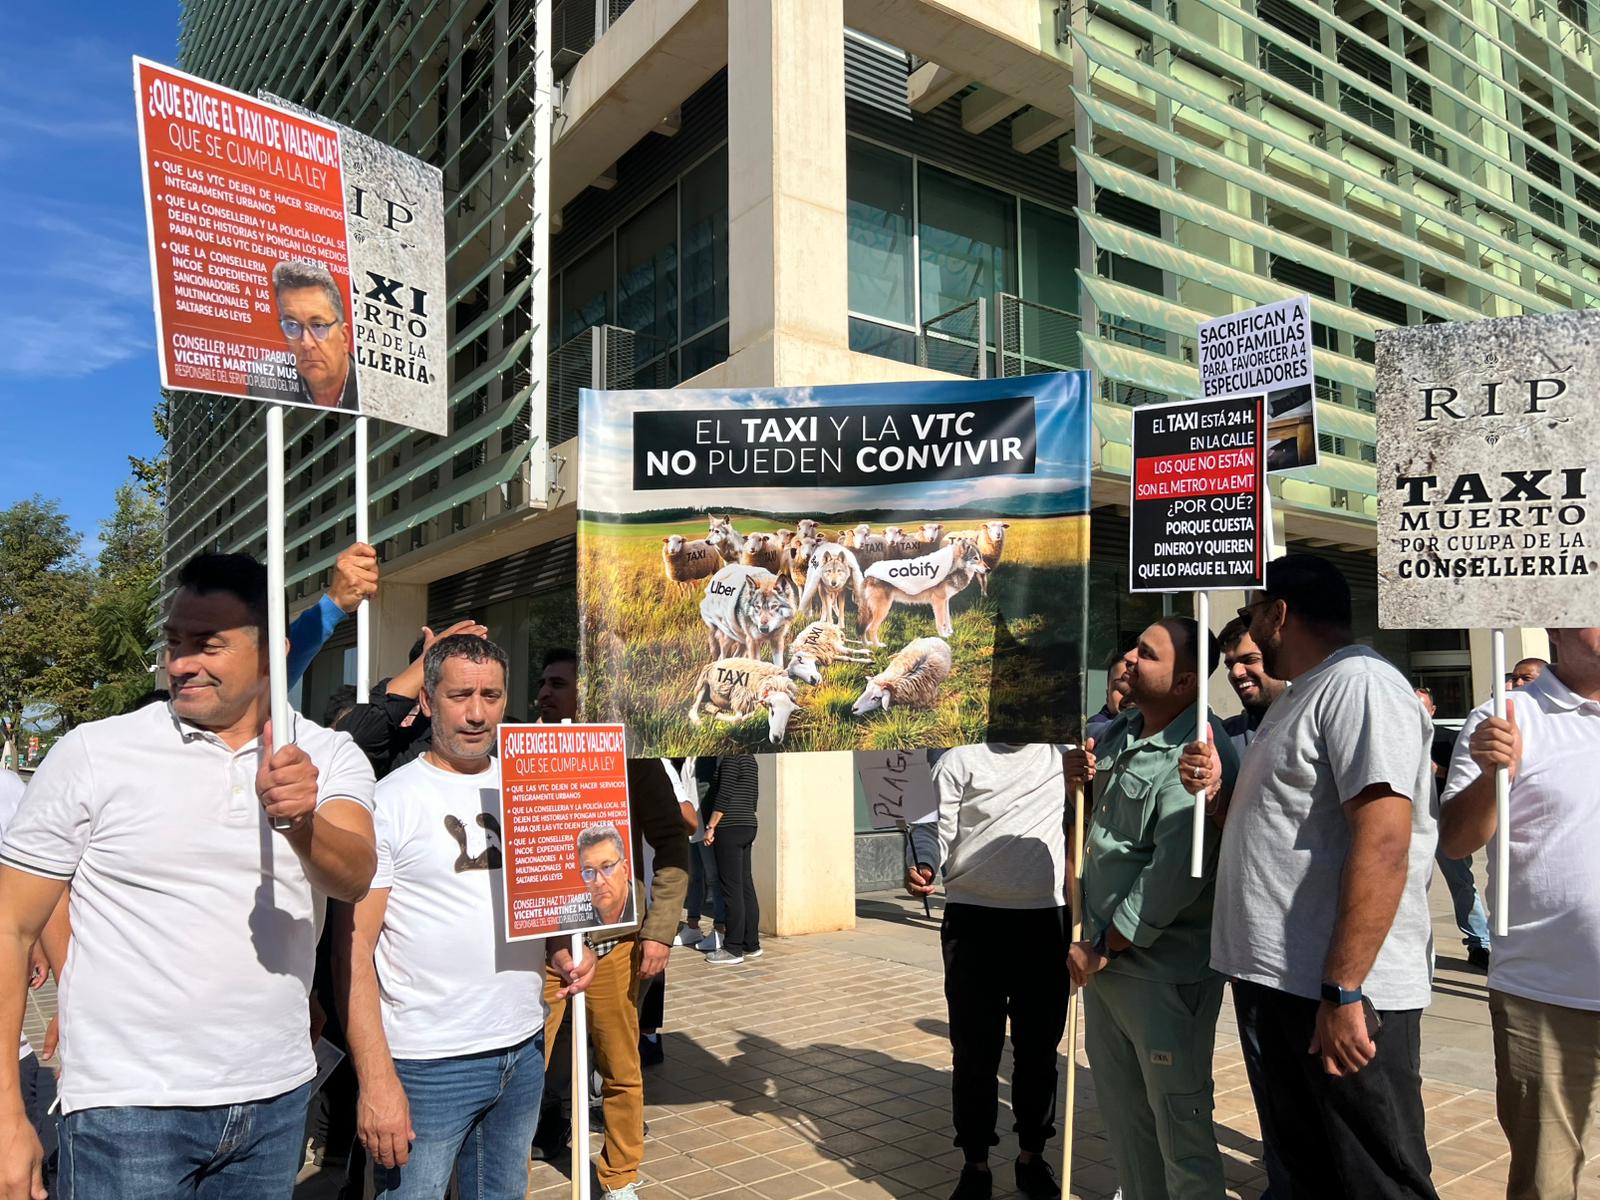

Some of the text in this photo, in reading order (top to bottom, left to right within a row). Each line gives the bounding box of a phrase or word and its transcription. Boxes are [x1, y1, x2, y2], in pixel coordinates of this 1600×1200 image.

[148, 78, 338, 169] ¿QUE EXIGE EL TAXI DE VALENCIA?
[168, 122, 327, 191] QUE SE CUMPLA LA LEY
[162, 161, 343, 220] QUE LAS VTC DEJEN DE HACER SERVICIOS
[165, 176, 276, 215] INTEGRAMENTE URBANOS
[165, 194, 344, 249] QUE LA CONSELLERIA Y LA POLICÍA LOCAL SE
[349, 184, 413, 238] IP
[169, 209, 346, 262] DEJEN DE HISTORIAS Y PONGAN LOS MEDIOS
[170, 223, 349, 276] PARA QUE LAS VTC DEJEN DE HACER DE TAXIS
[170, 242, 266, 272] QUE LA CONSELLERIA
[173, 257, 267, 286] INCOE EXPEDIENTES
[174, 271, 269, 299] SANCIONADORES A LAS
[175, 286, 270, 313] MULTINACIONALES POR
[350, 269, 428, 318] XI
[176, 300, 252, 323] SALTARSE LAS LEYES
[1200, 303, 1303, 344] SACRIFICAN A
[173, 334, 296, 366] CONSELLER HAZ TU TRABAJO
[382, 332, 402, 351] DE
[408, 340, 426, 359] LA
[1201, 322, 1304, 363] 7000 FAMILIAS
[175, 349, 220, 367] VICENTE
[278, 366, 297, 379] MUS
[356, 345, 428, 384] LLERÍA
[1202, 341, 1305, 378] PARA FAVORECER A 4
[1204, 358, 1306, 396] ESPECULADORES
[696, 411, 975, 444] EL TAXI Y LA VTC
[1153, 409, 1254, 433] EL TAXI ESTÁ 24 H.
[1190, 430, 1253, 450] EN LA CALLE
[647, 436, 1023, 476] NO PUEDEN CONVIVIR
[1154, 449, 1253, 474] LOS QUE NO ESTÁN
[1138, 474, 1253, 495] SON EL METRO Y LA EMT
[1396, 468, 1587, 507] TAXI
[1167, 493, 1252, 517] ¿POR QUÉ?
[1399, 505, 1586, 531] MUERTO
[1166, 517, 1253, 535] PORQUE CUESTA
[687, 549, 706, 562] TAXI
[865, 543, 884, 553] TAXI
[900, 541, 920, 552] TAXI
[1154, 538, 1252, 555] DINERO Y QUIEREN
[1400, 532, 1585, 552] POR CULPA DE LA
[889, 562, 940, 579] cabify
[1138, 560, 1252, 579] QUE LO PAGUE EL TAXI
[1399, 550, 1588, 578] CONSELLERÍA
[710, 581, 736, 596] Uber
[805, 627, 823, 645] TAXI
[717, 668, 749, 686] TAXI
[504, 732, 623, 759] ¿QUE EXIGE EL TAXI DE VALENCIA?
[515, 756, 615, 775] QUE SE CUMPLA LA LEY
[873, 750, 913, 818] PLAG
[514, 908, 541, 920] VICENTE
[578, 901, 592, 912] MUS
